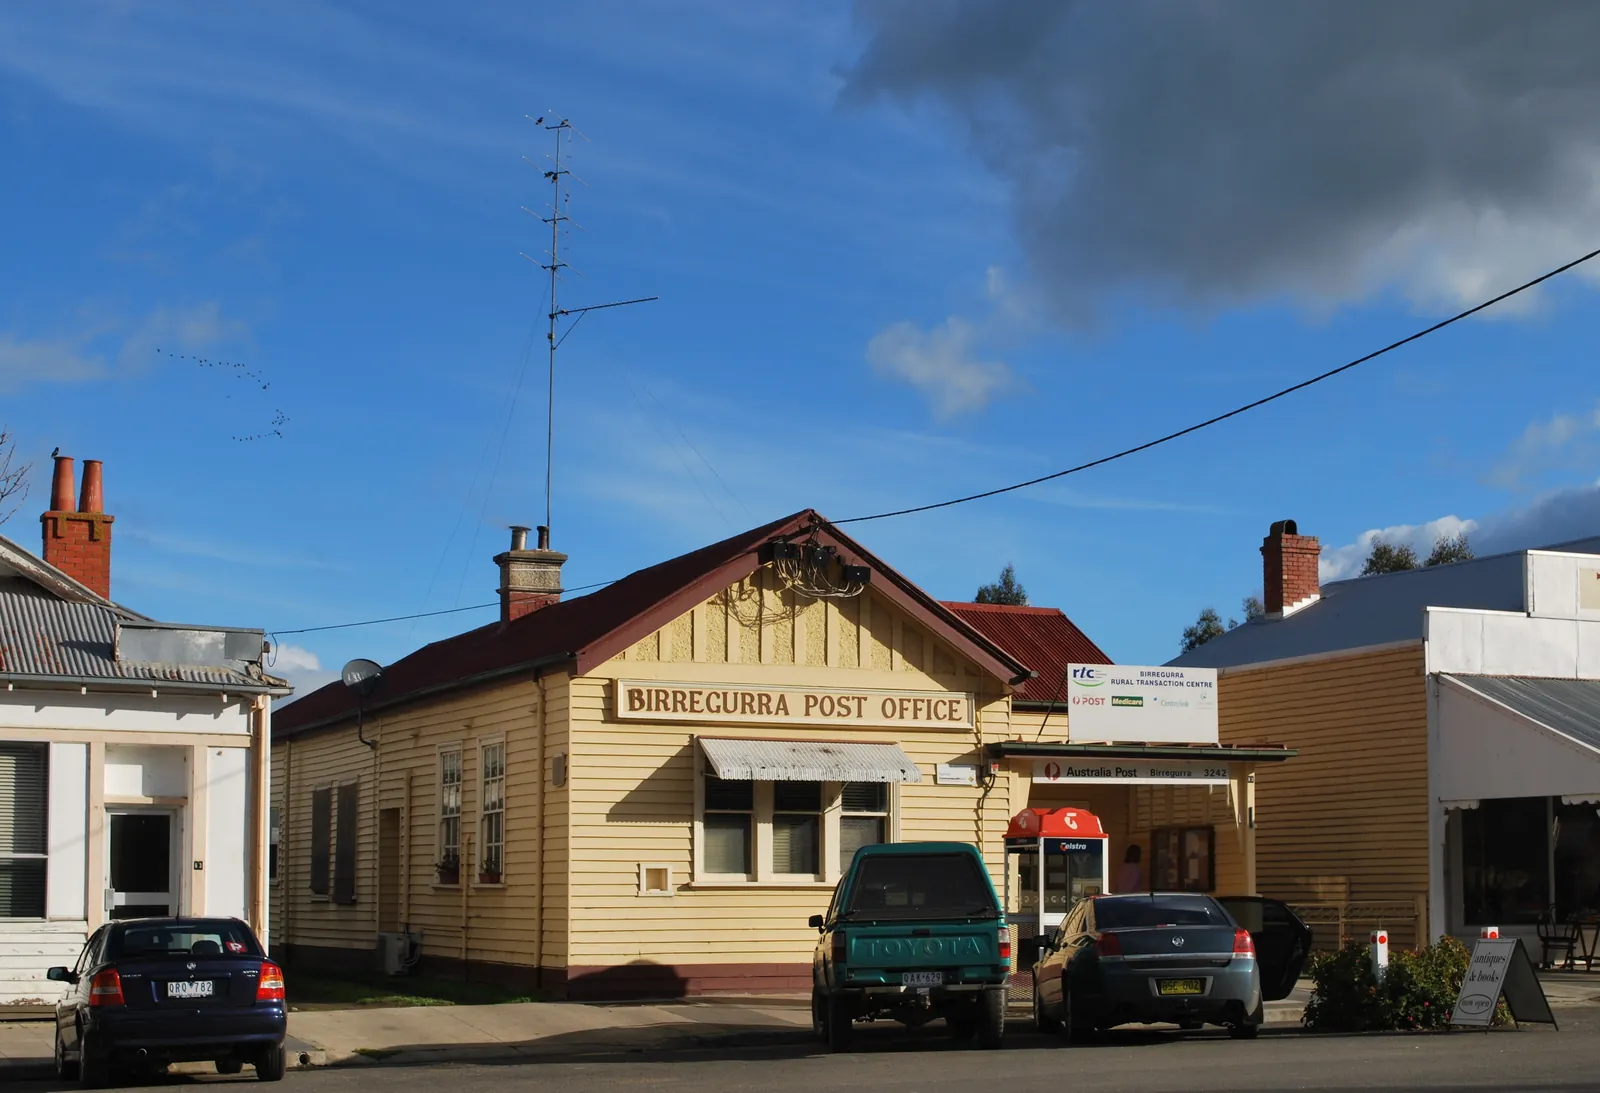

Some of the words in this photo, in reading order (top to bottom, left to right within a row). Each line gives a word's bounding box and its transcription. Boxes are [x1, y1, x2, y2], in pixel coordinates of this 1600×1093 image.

[1139, 671, 1184, 679] BIRREGURRA
[1136, 679, 1184, 687] TRANSACTION
[627, 687, 790, 717] BIRREGURRA
[803, 693, 868, 719] POST
[880, 696, 964, 722] OFFICE
[1082, 697, 1106, 706] POST
[1112, 697, 1143, 706] Medicare
[1066, 767, 1112, 778] Australia
[1115, 767, 1138, 778] Post
[1150, 768, 1192, 779] Birregurra
[1203, 768, 1227, 777] 3242
[1060, 842, 1087, 852] Telstra
[866, 937, 981, 957] TOYOTA
[1474, 952, 1506, 967] antiques
[1477, 970, 1499, 982] books
[194, 981, 212, 992] 782
